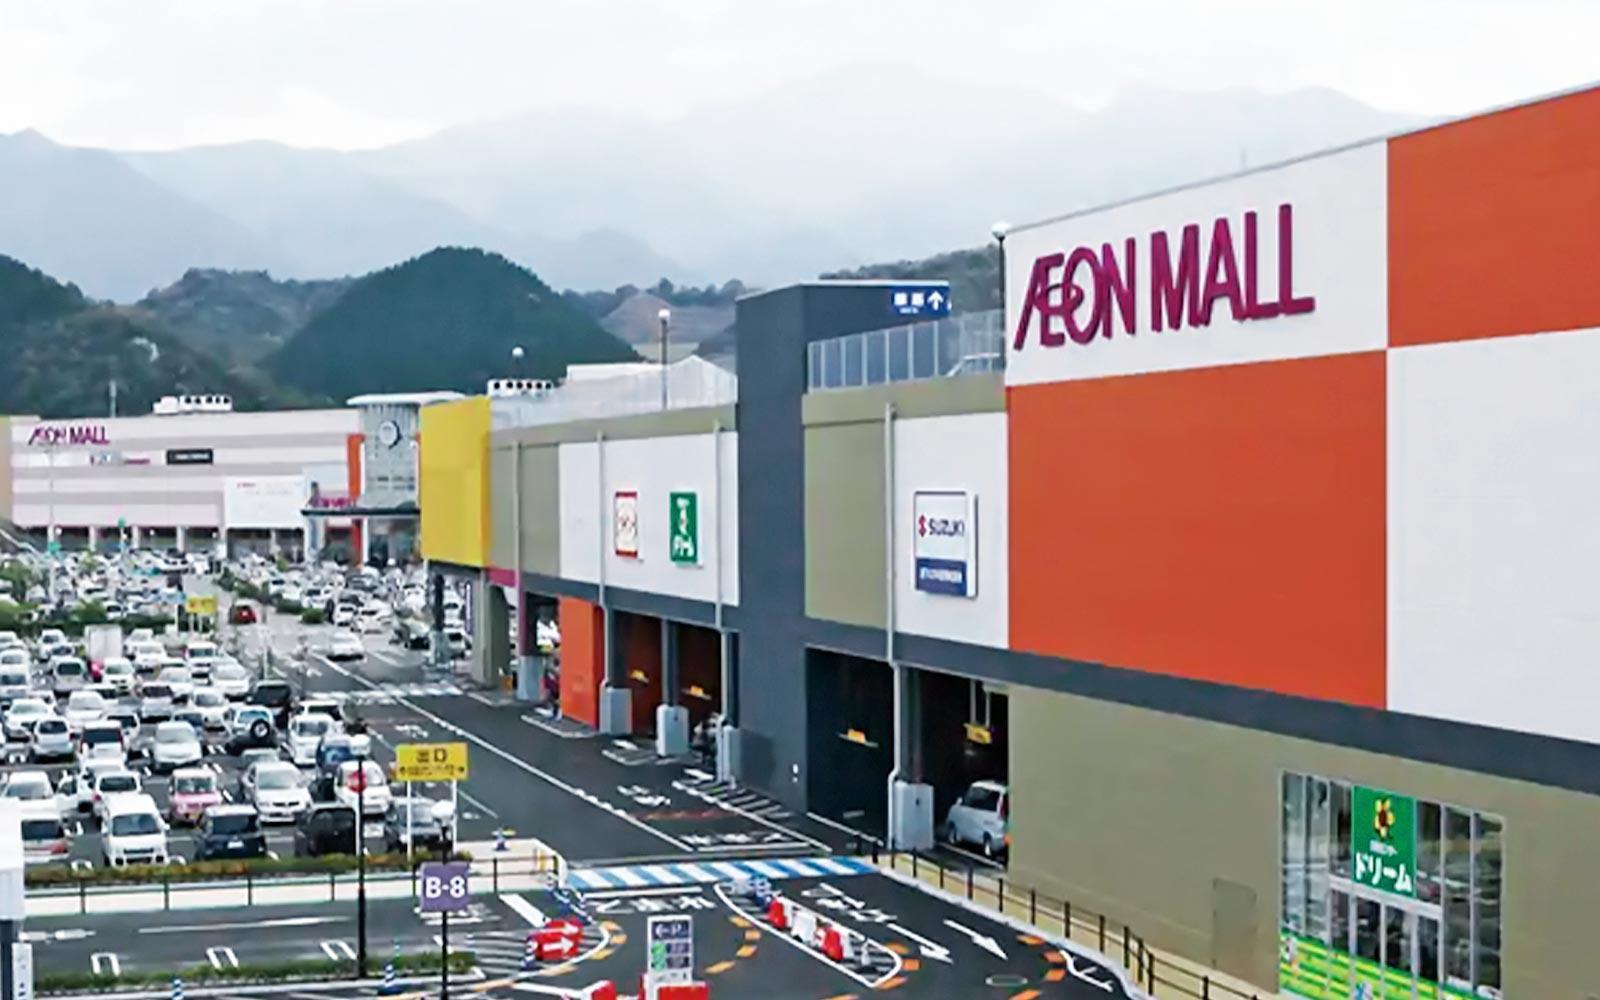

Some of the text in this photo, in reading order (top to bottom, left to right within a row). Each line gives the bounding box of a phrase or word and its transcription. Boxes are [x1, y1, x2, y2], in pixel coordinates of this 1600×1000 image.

[1151, 203, 1315, 333] MALL
[69, 426, 110, 444] MALL
[928, 517, 965, 537] SUZUKI
[1356, 851, 1412, 892] ドリーム
[425, 875, 465, 899] B-8
